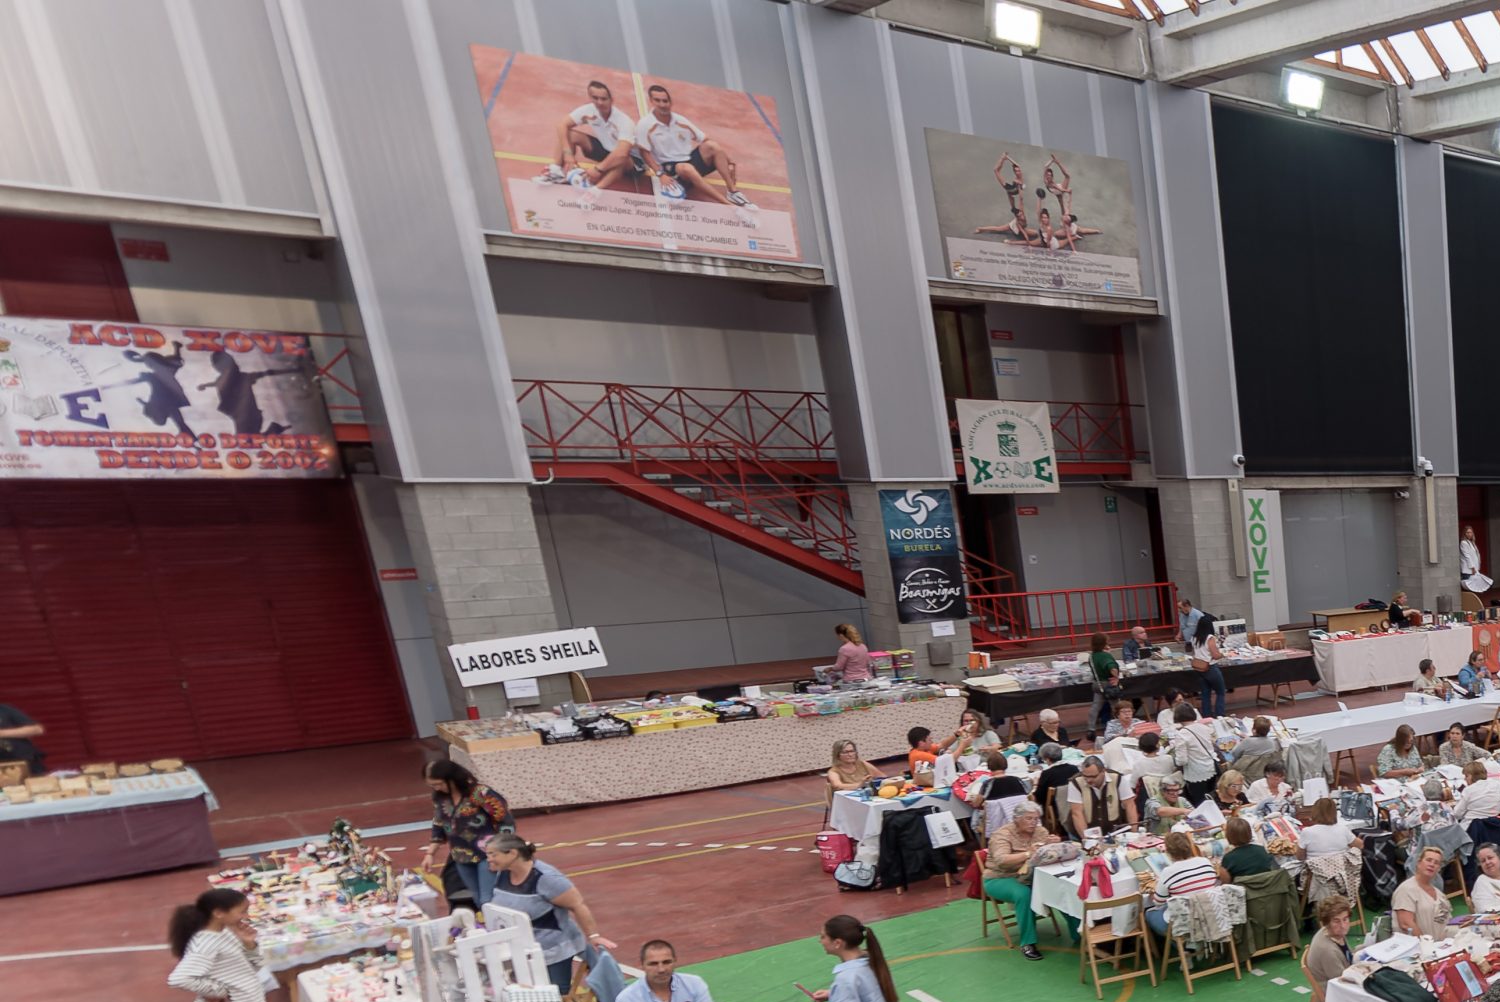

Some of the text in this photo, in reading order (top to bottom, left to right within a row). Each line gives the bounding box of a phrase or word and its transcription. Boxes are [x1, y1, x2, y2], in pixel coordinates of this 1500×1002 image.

[600, 224, 634, 235] GALEGO
[69, 322, 306, 356] ACD XOVE
[15, 429, 321, 449] FOMENTANDO O DEPORTE
[95, 449, 329, 471] DENDE O 2002
[889, 525, 952, 540] NORDÉS
[904, 543, 943, 552] BURELA
[1247, 498, 1272, 594] XOVE
[455, 639, 600, 673] LABORES SHEILA
